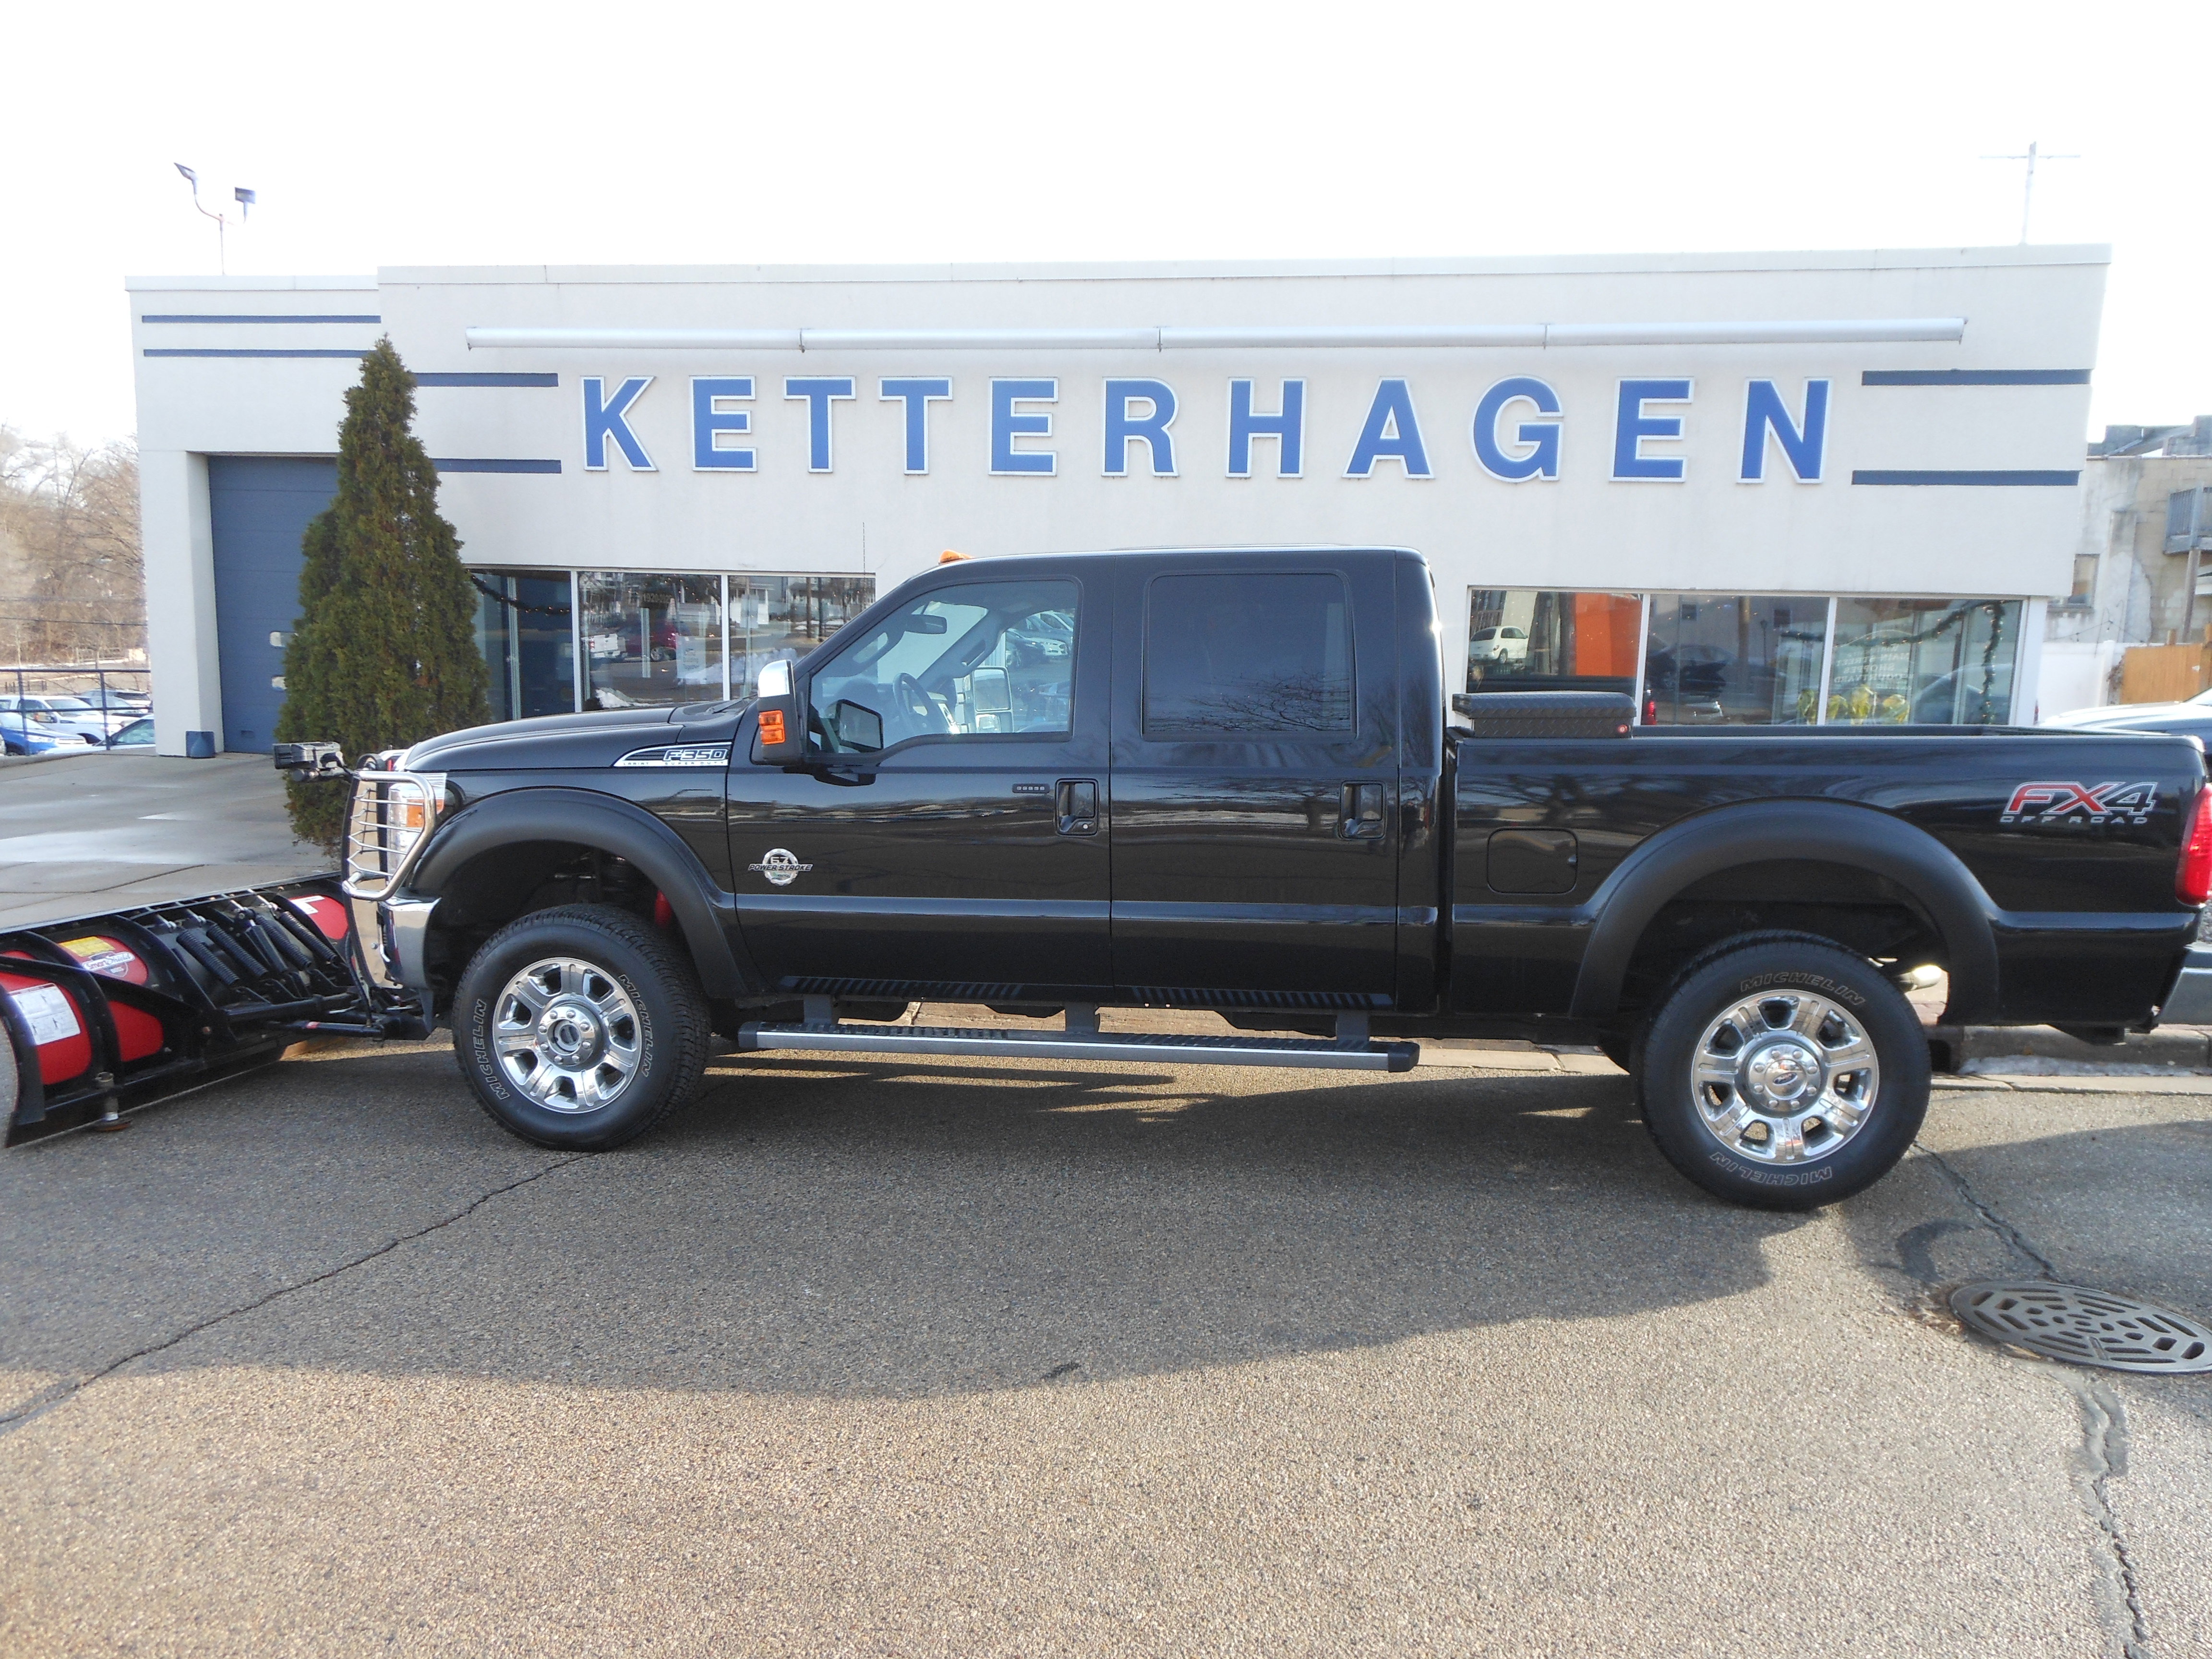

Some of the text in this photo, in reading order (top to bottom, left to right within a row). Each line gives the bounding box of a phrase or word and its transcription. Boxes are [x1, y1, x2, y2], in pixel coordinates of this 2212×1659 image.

[580, 374, 1833, 484] KETTERHAGEN
[2003, 781, 2158, 816] FX4
[2068, 816, 2148, 824] ROAD
[1740, 972, 1866, 1006] MICHELIN
[619, 974, 655, 1078] MICHELIN
[470, 998, 510, 1101] MICHELIN
[1709, 1151, 1833, 1186] MICHELIN
